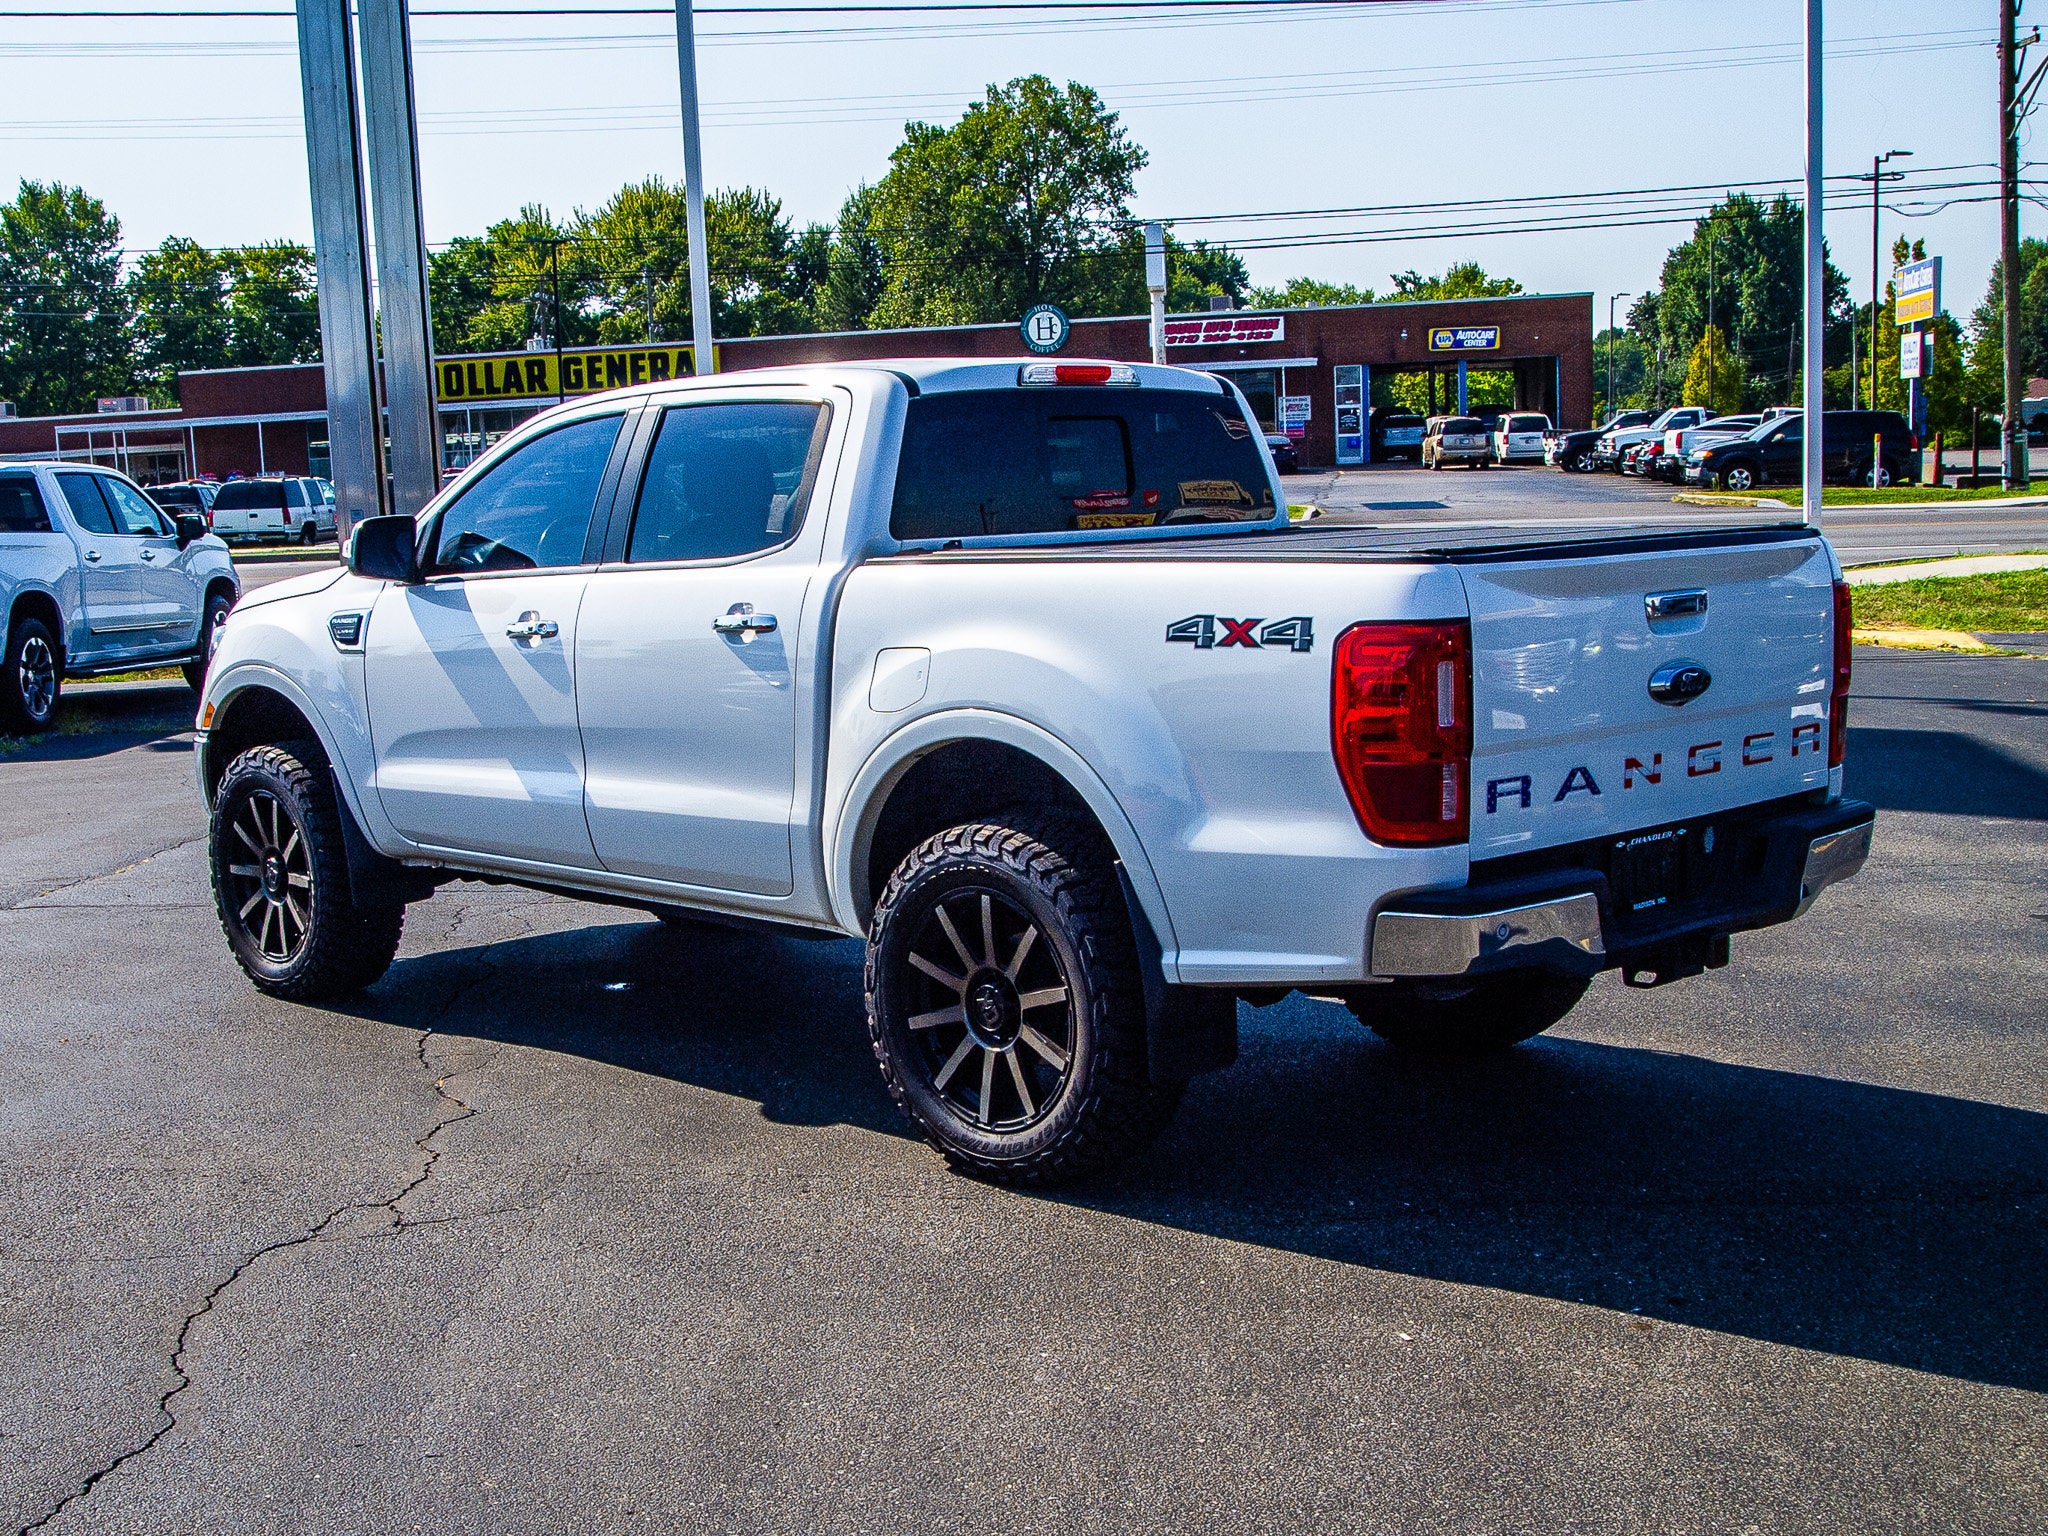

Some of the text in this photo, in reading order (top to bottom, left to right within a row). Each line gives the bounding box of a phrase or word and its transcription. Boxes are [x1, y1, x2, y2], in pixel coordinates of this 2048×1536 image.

[1203, 321, 1233, 333] AUTO
[1233, 319, 1279, 331] SERVICE
[1463, 339, 1487, 347] CENTER
[434, 358, 550, 398] OLLAR
[1486, 722, 1822, 814] RANGER
[1630, 831, 1673, 846] CHANDLER
